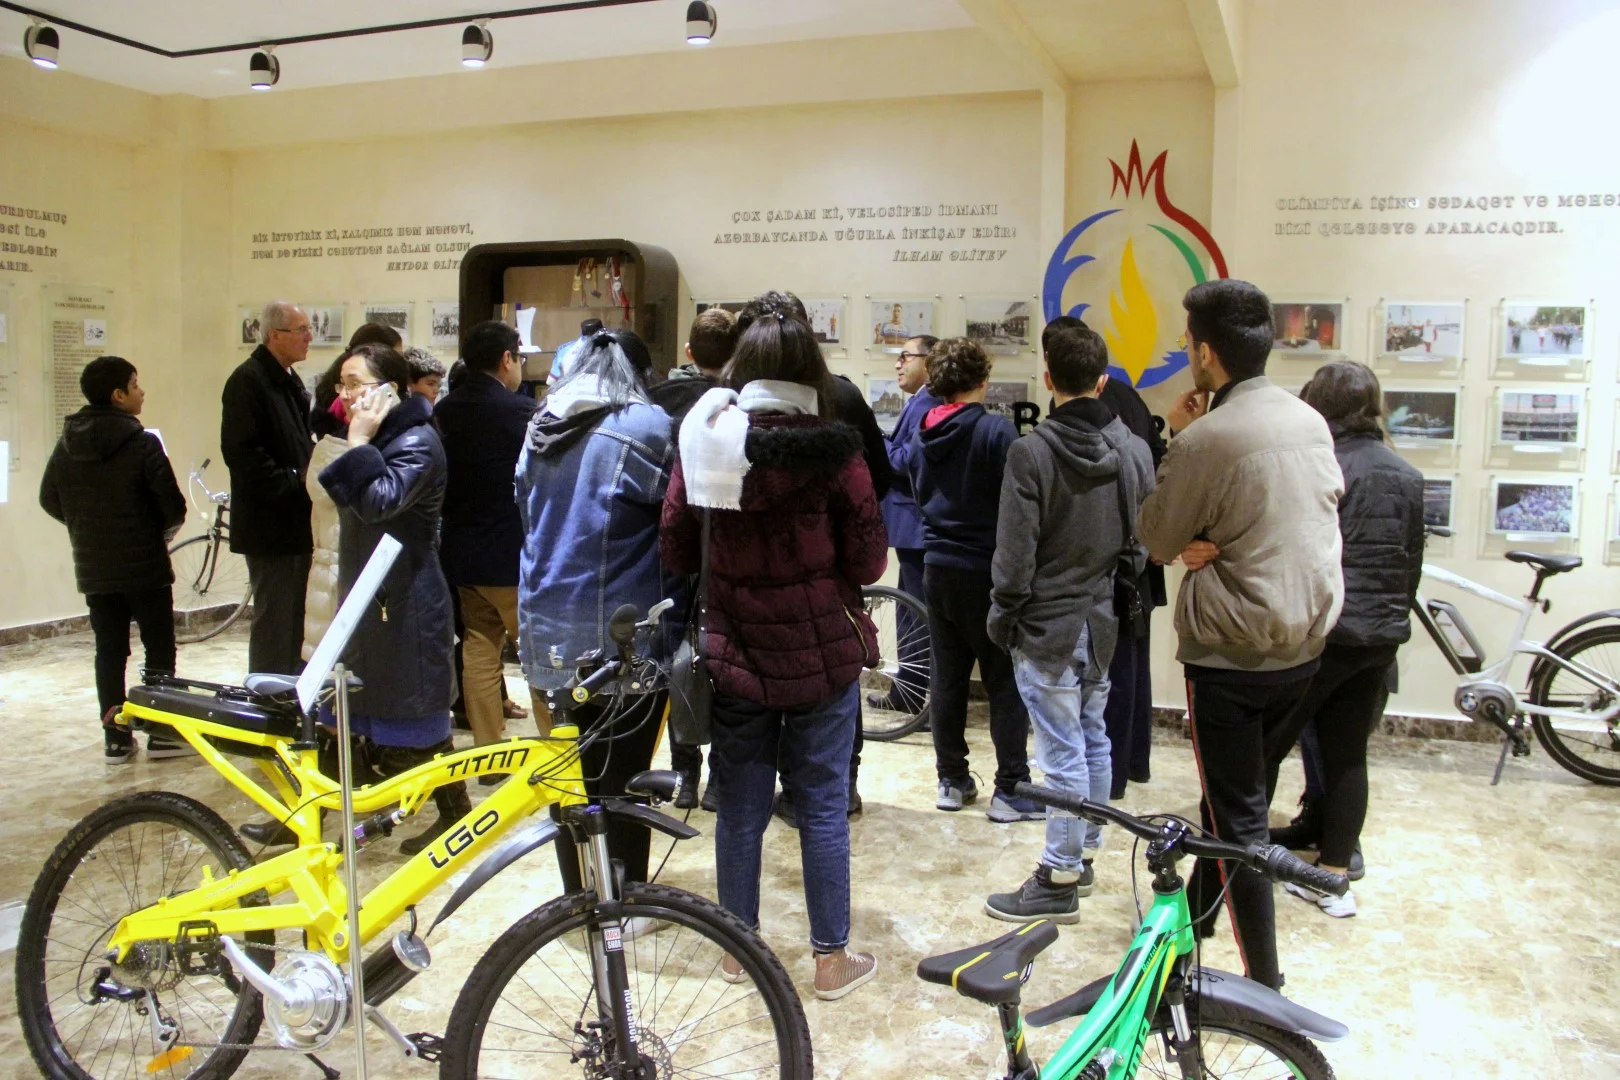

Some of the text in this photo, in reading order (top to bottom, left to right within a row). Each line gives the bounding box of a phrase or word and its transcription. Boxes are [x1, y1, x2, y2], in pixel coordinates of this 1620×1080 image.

[1557, 194, 1620, 207] MƏHƏ
[732, 211, 761, 224] ÇOX
[766, 209, 816, 223] ŞADAM
[847, 204, 932, 218] VELOSİPED
[938, 203, 998, 217] İDMANI
[713, 230, 829, 244] AZƏRBAYCANDA
[834, 228, 896, 241] UĞURLA
[902, 226, 966, 241] İNKİŞAF
[892, 248, 1008, 262] İLHAM ƏLİYEV
[433, 258, 460, 270] ƏLİY
[446, 748, 530, 777] TITAN
